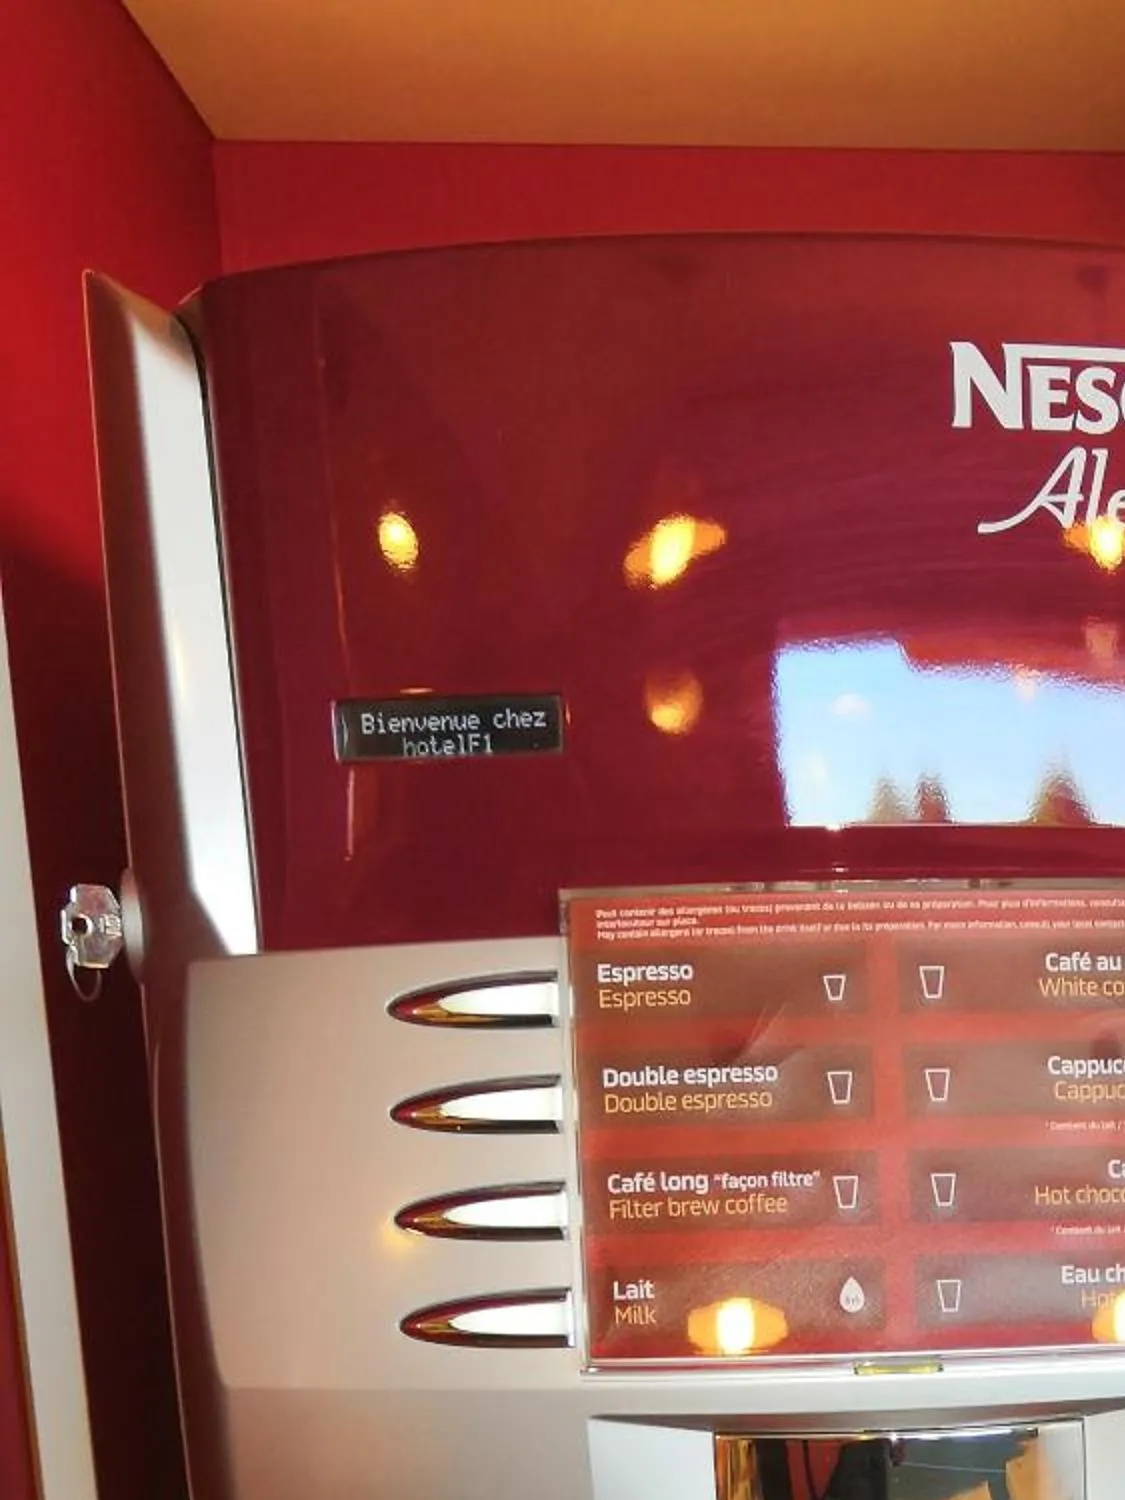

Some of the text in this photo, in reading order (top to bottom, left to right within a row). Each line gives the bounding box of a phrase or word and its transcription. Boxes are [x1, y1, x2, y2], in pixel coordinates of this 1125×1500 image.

[361, 708, 548, 735] Bienvenue chez
[403, 733, 494, 757] hotelF1
[1044, 951, 1091, 973] Café
[1096, 956, 1123, 972] au
[597, 962, 694, 987] Espresso
[1038, 975, 1098, 998] White
[598, 987, 692, 1012] Espresso
[602, 1064, 779, 1090] Double espresso
[604, 1089, 773, 1114] Double espresso
[606, 1171, 656, 1195] Café
[660, 1171, 710, 1195] long
[608, 1193, 788, 1220] Filter brew coffee
[1034, 1185, 1071, 1206] Hot
[1060, 1264, 1100, 1285] Eau
[612, 1279, 656, 1301] Lait
[614, 1303, 657, 1327] Milk
